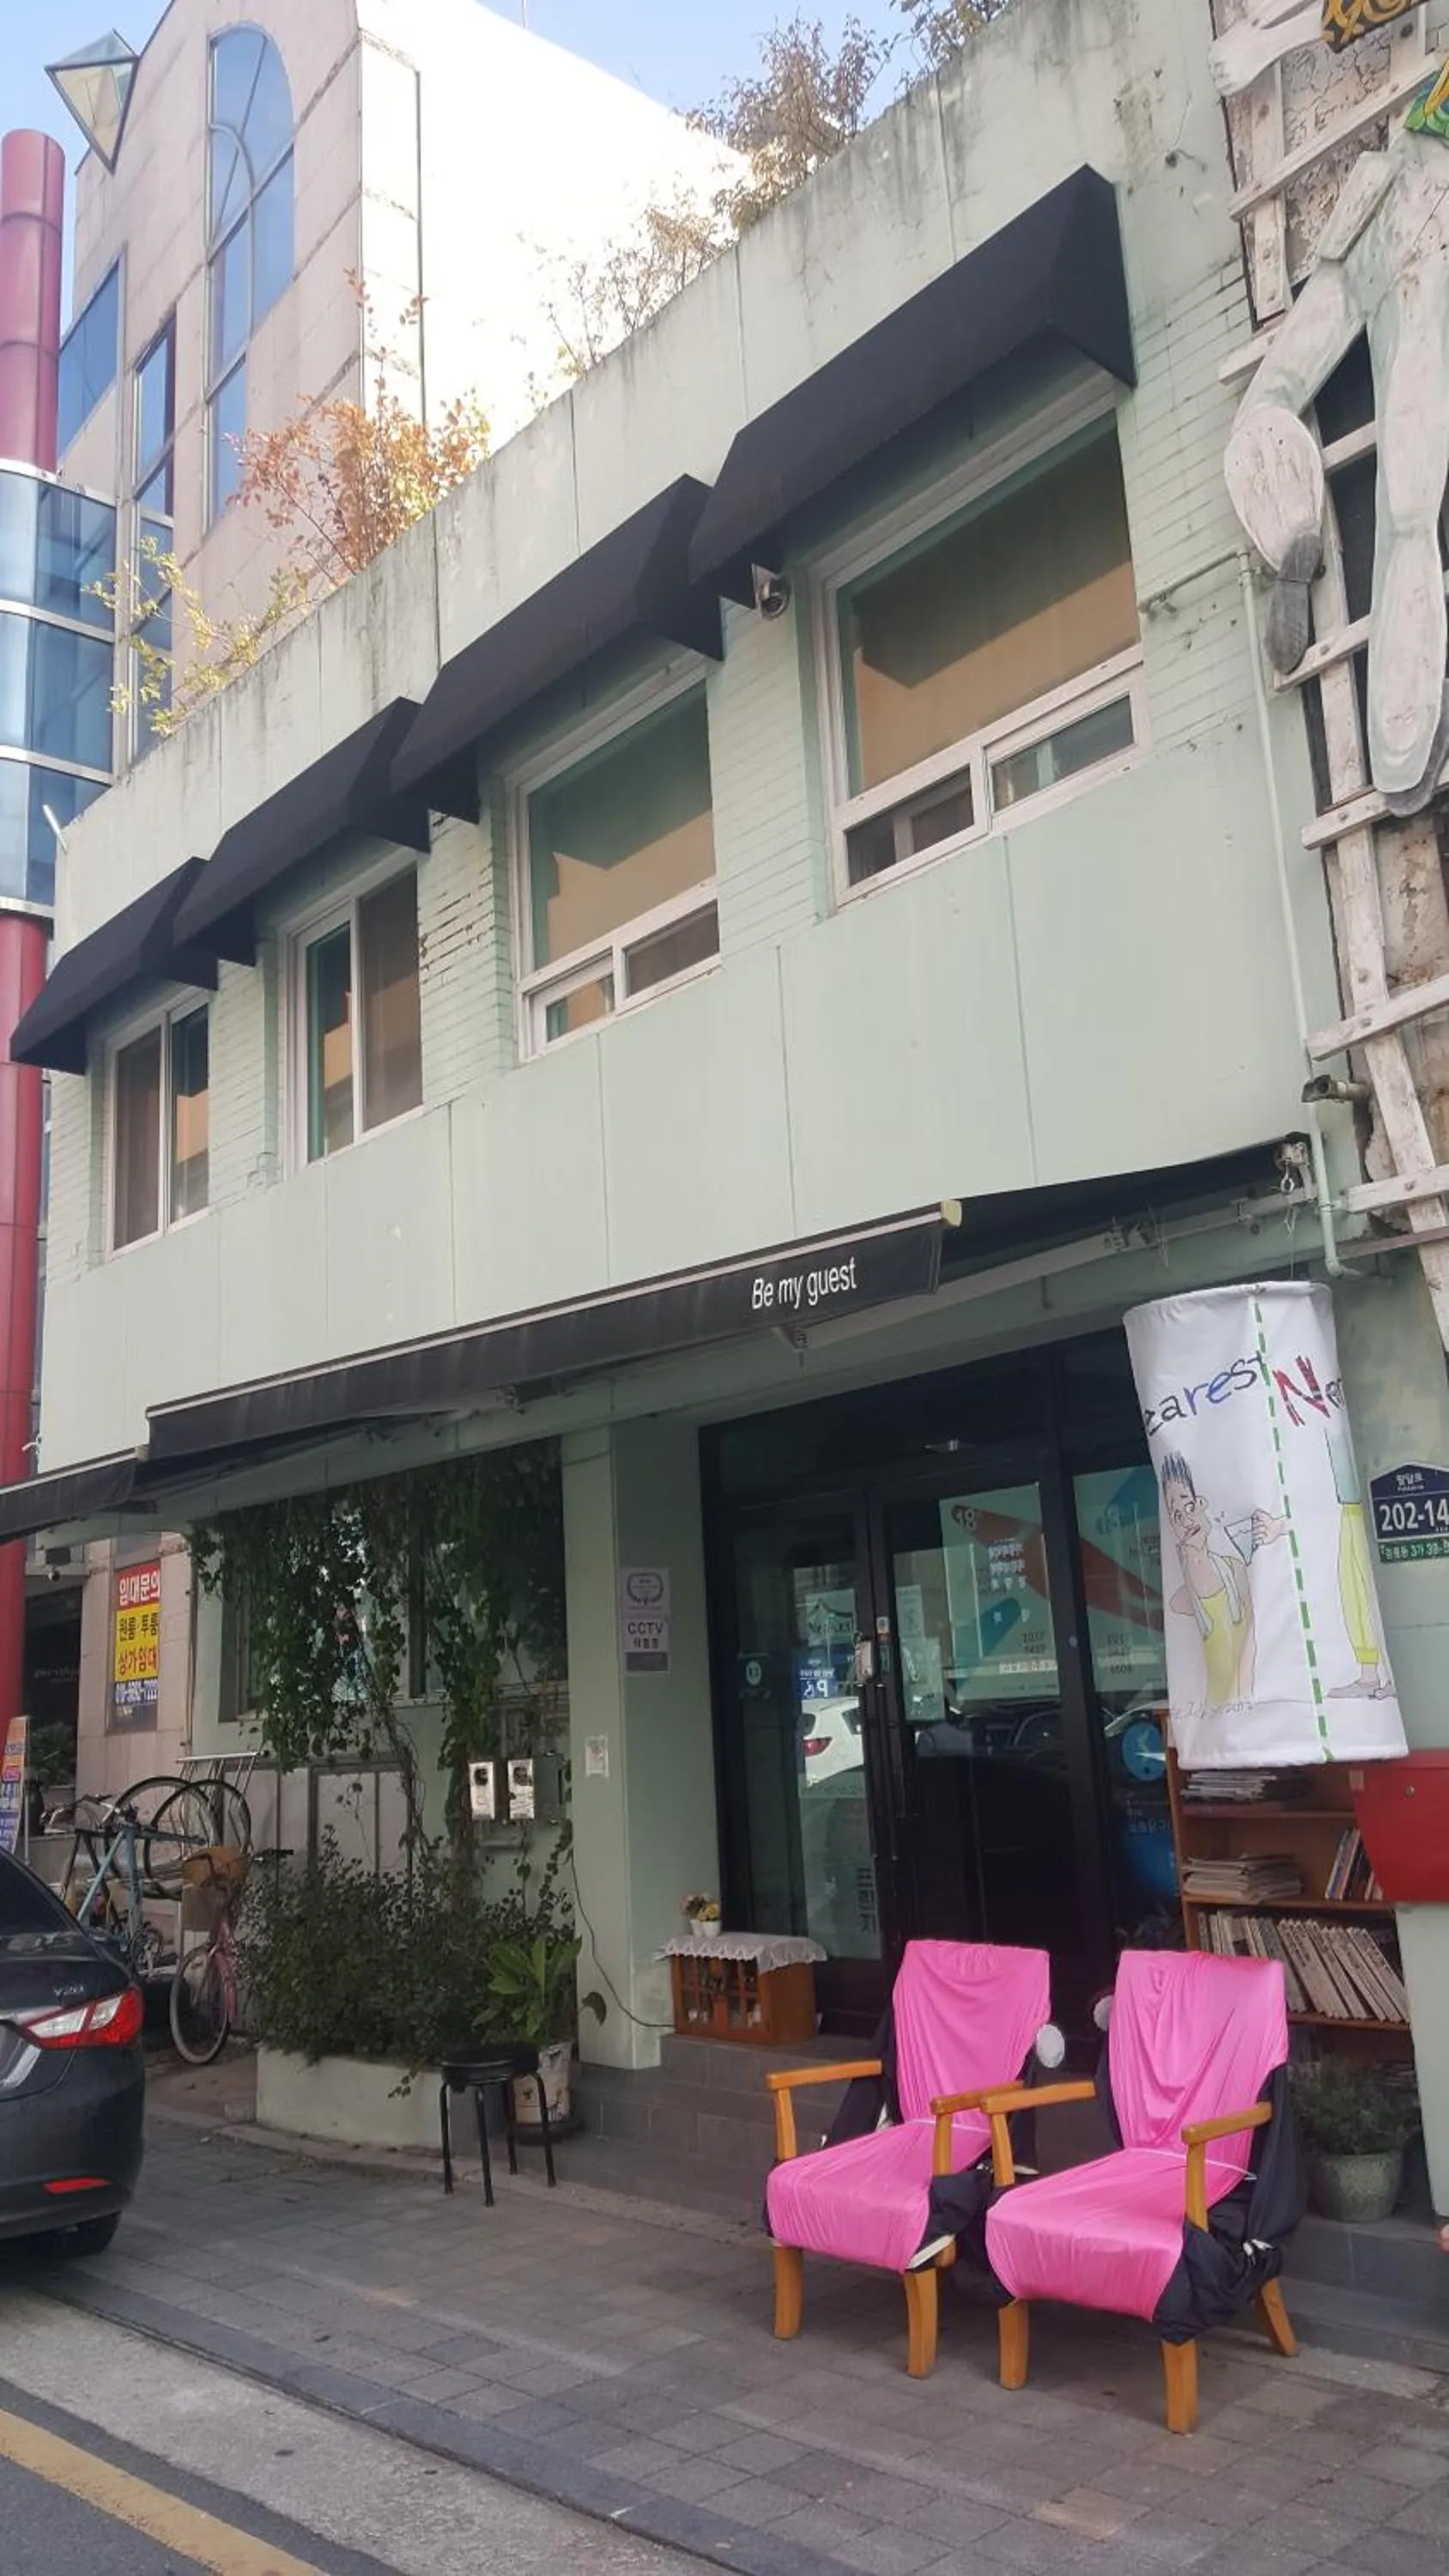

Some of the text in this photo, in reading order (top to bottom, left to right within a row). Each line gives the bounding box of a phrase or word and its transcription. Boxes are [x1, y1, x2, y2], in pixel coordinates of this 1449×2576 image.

[751, 1256, 857, 1309] Be my guest
[1379, 1498, 1449, 1531] 202-14
[118, 1571, 161, 1606] 임대문의
[627, 1621, 664, 1636] CCTV
